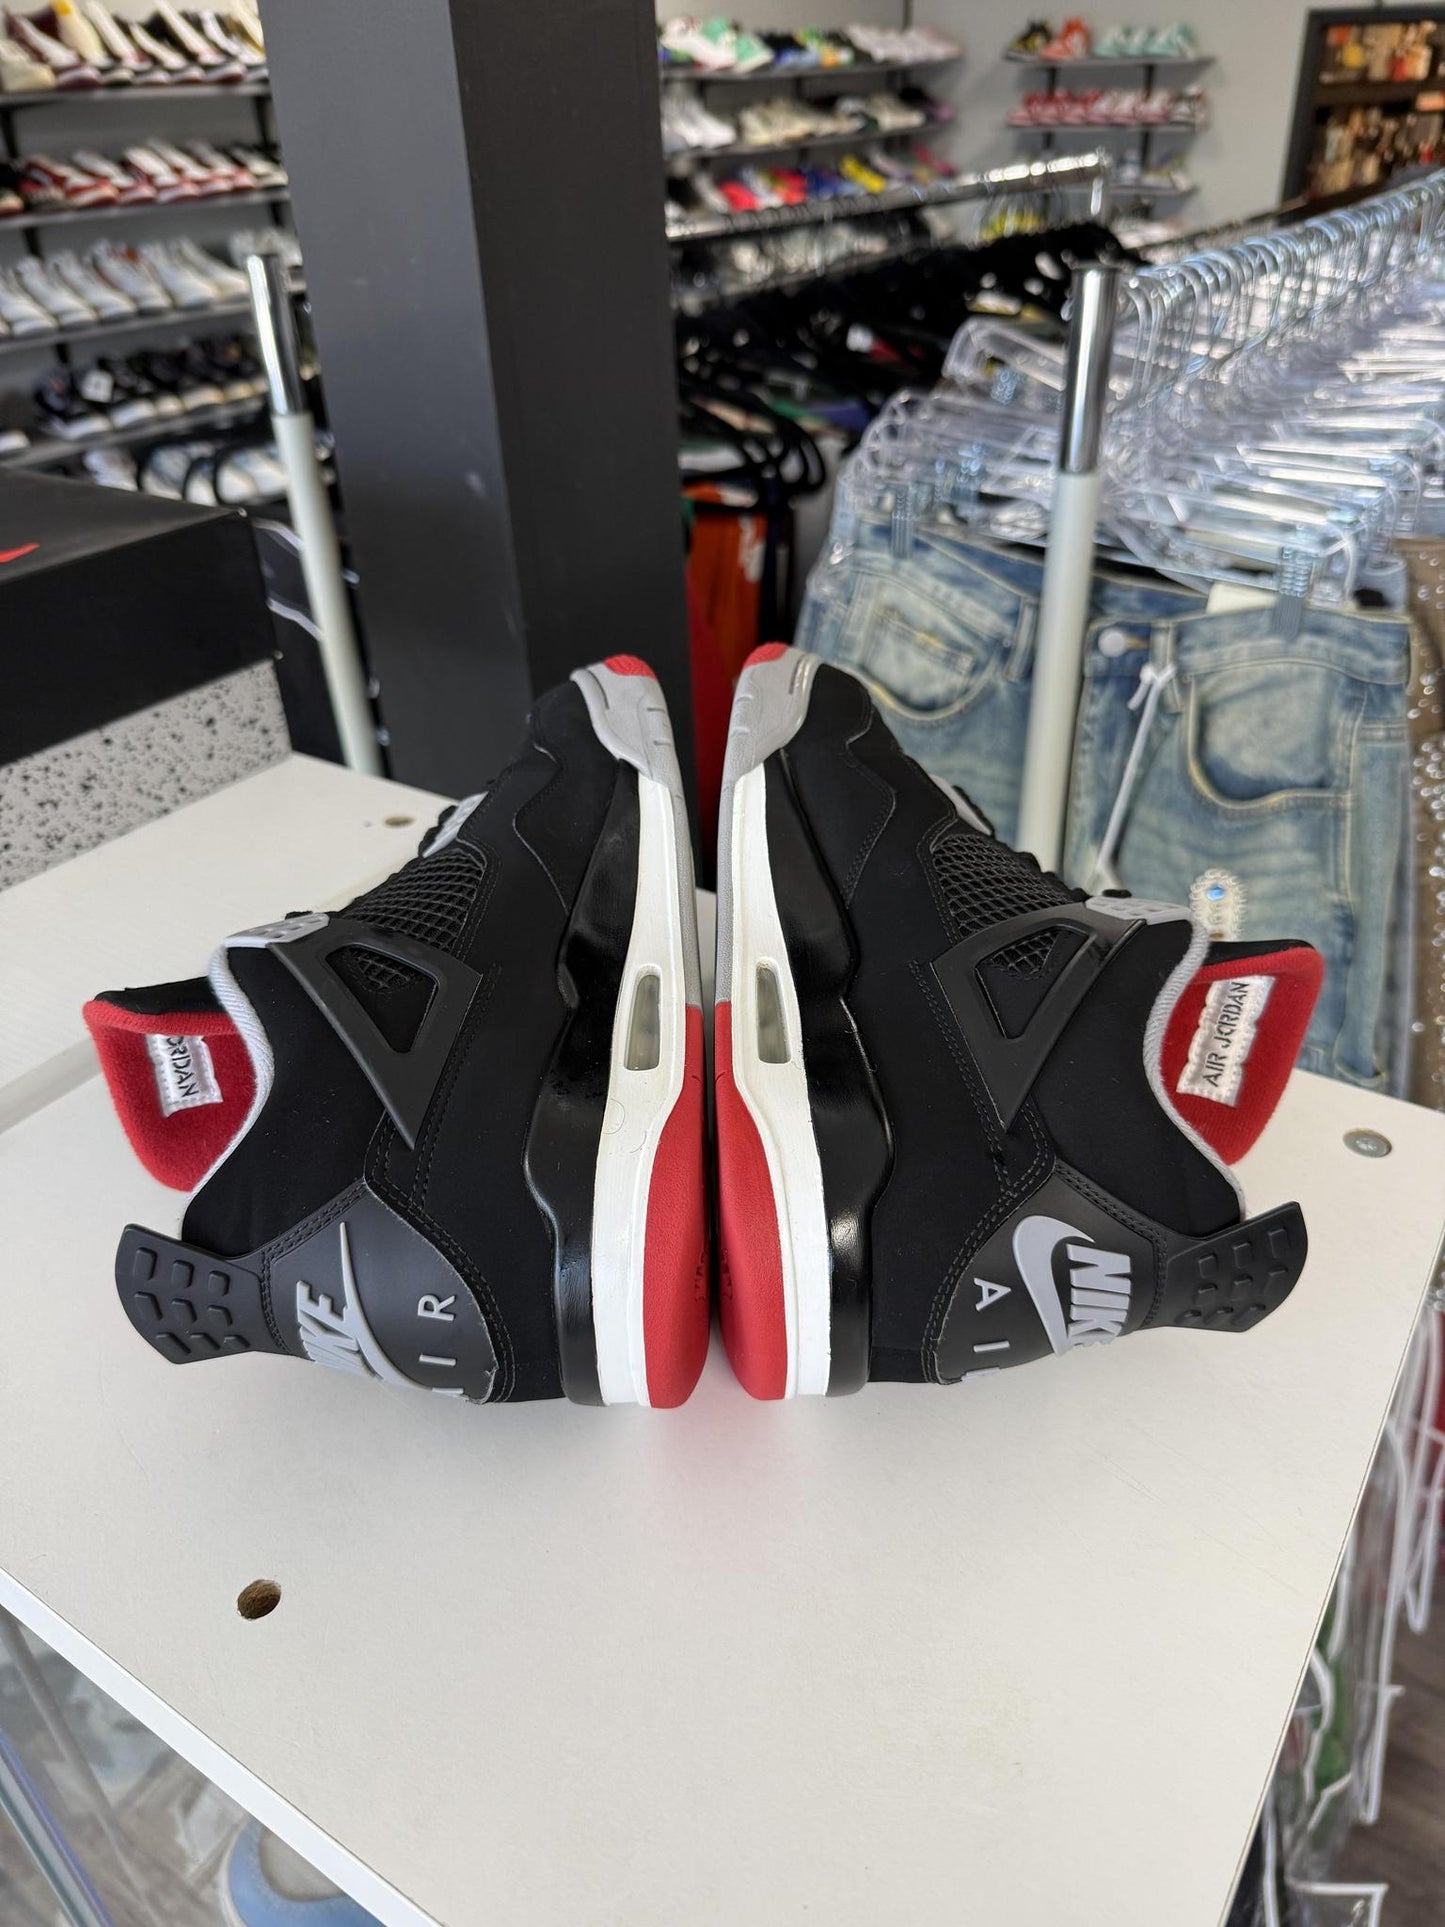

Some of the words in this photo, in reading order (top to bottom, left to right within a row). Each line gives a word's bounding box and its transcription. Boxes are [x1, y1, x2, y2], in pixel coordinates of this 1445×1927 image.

[1213, 981, 1251, 1048] JORDAN
[166, 1035, 200, 1098] ORDAN
[1203, 1052, 1226, 1088] AIR
[417, 1293, 464, 1395] IR
[963, 1277, 1012, 1382] AI
